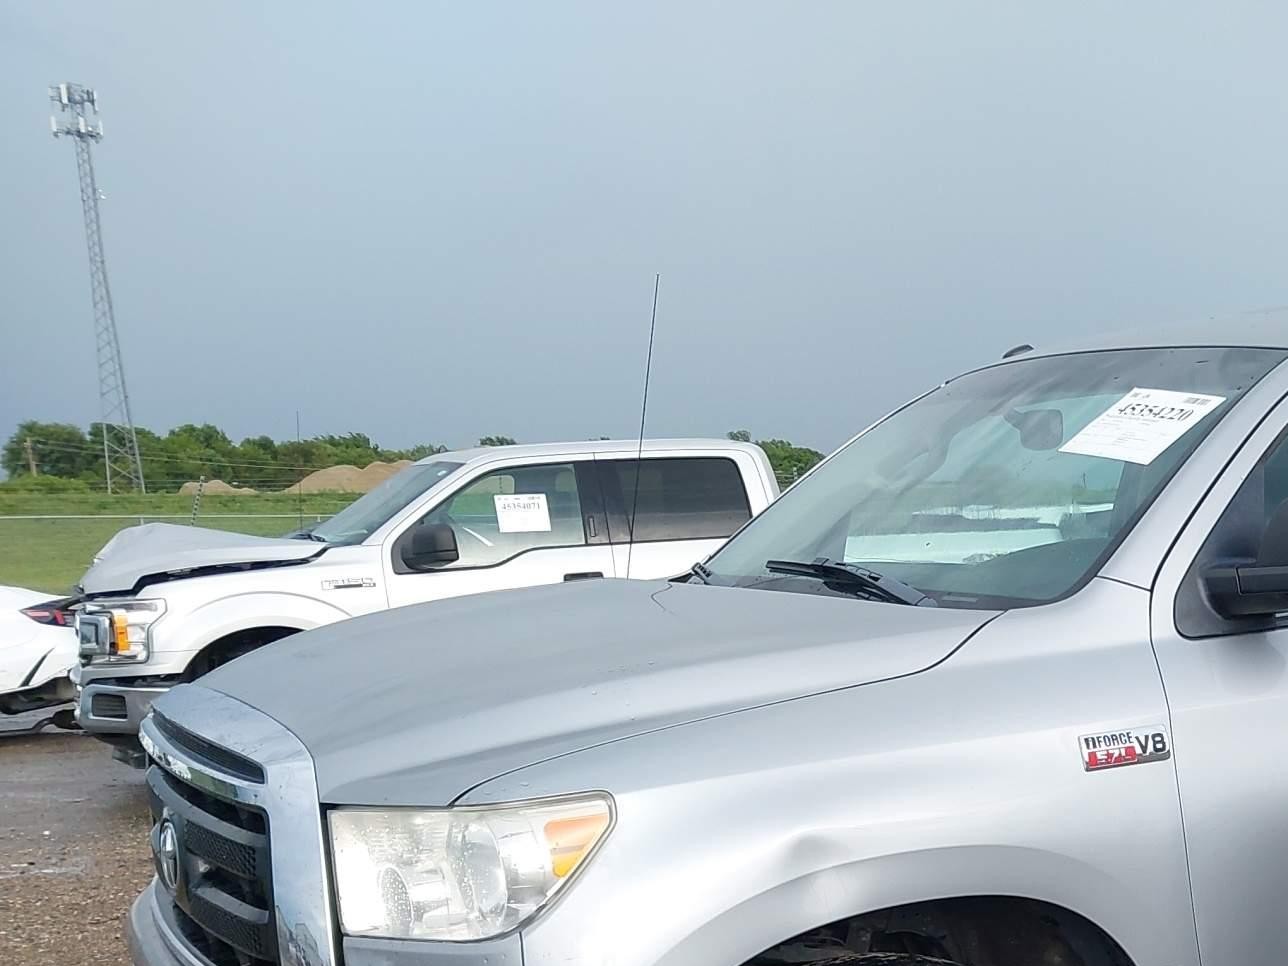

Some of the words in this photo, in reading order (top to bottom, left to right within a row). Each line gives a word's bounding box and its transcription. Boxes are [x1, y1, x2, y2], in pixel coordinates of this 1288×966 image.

[1118, 403, 1195, 421] 45354220
[1135, 732, 1167, 755] V8
[1095, 746, 1134, 764] 5.7L
